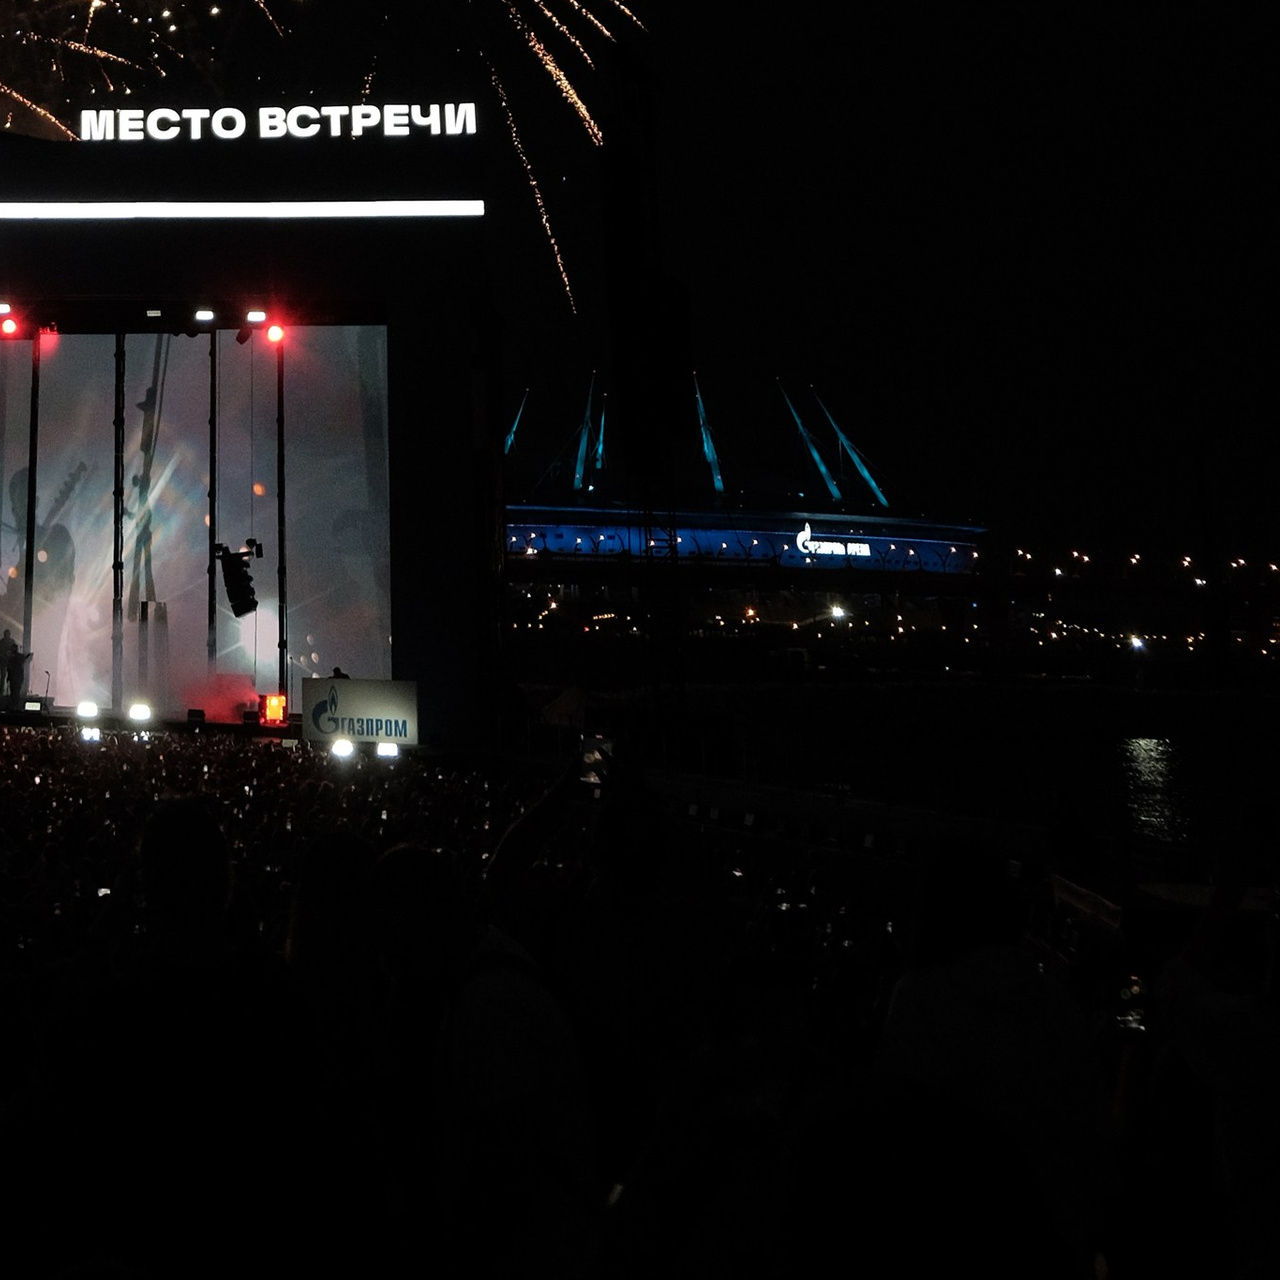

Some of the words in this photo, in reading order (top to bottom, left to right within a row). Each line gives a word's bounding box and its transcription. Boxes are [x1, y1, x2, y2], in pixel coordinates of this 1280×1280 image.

[80, 107, 246, 141] МЕСТО
[258, 102, 477, 139] ВСТРЕЧИ
[340, 717, 408, 738] ГАЗПРОМ
